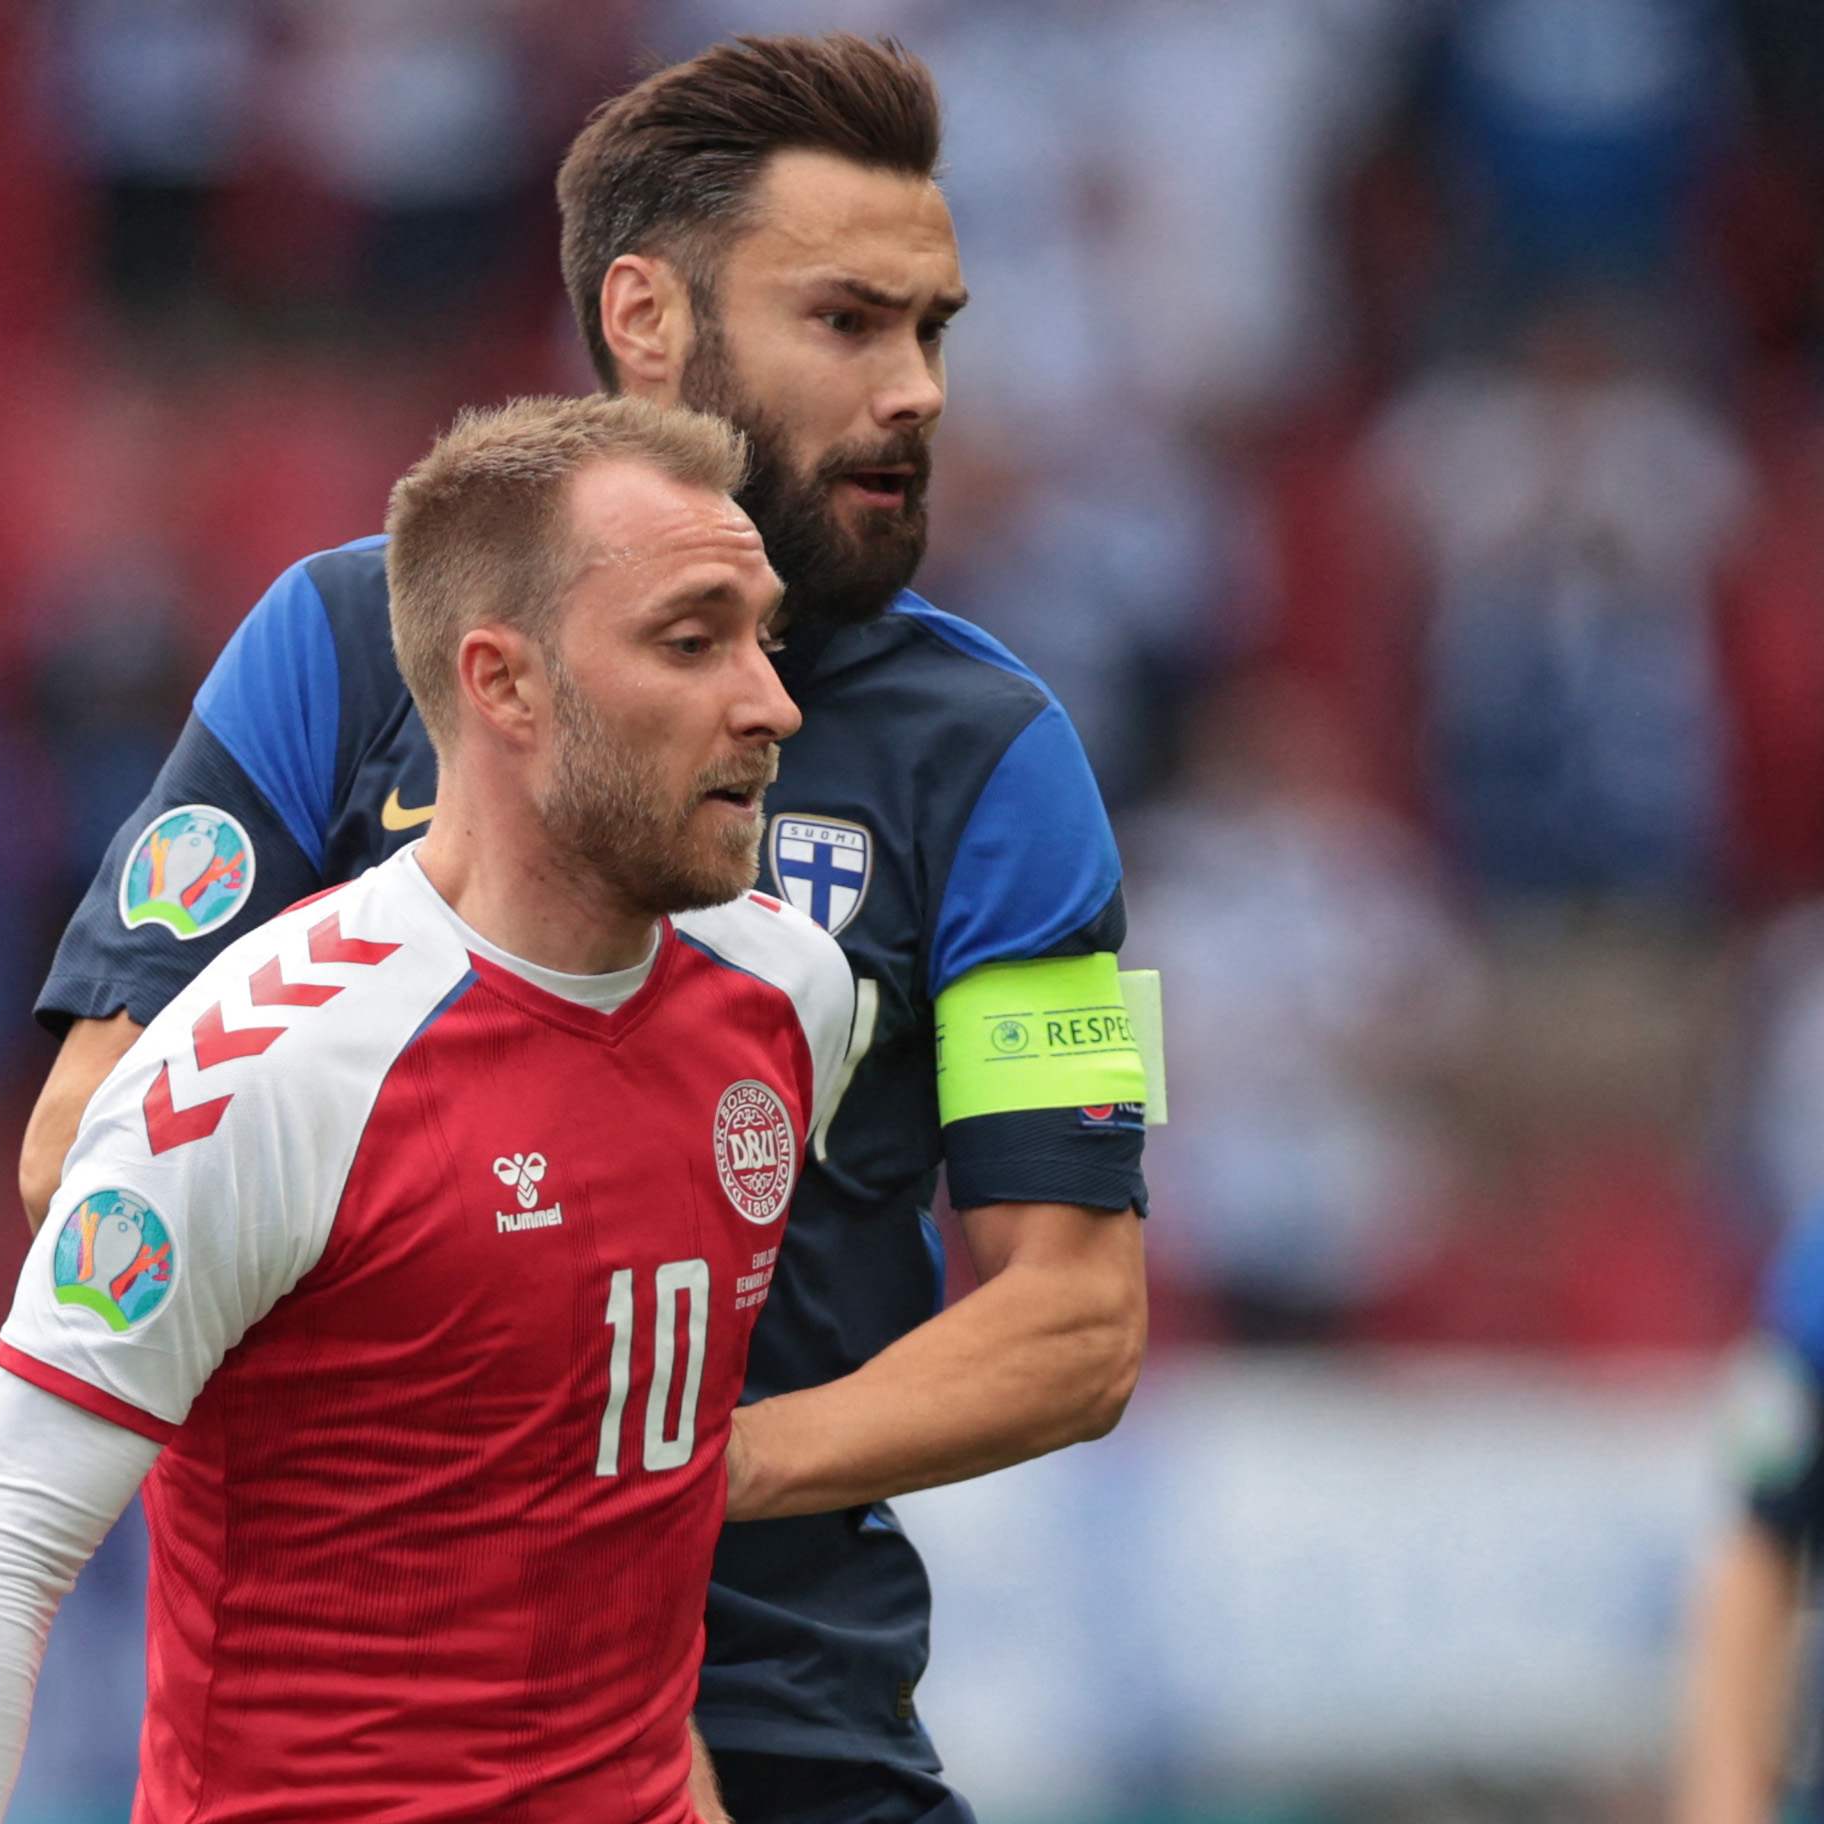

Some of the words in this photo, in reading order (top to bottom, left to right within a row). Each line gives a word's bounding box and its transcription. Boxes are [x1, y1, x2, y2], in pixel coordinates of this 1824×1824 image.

[790, 826, 857, 846] SUOMI
[715, 1126, 744, 1205] DANSK
[727, 1128, 778, 1171] DBU
[775, 1122, 790, 1194] UNION
[495, 1202, 563, 1233] hummel
[746, 1197, 776, 1217] 1889
[595, 1257, 710, 1476] 10
